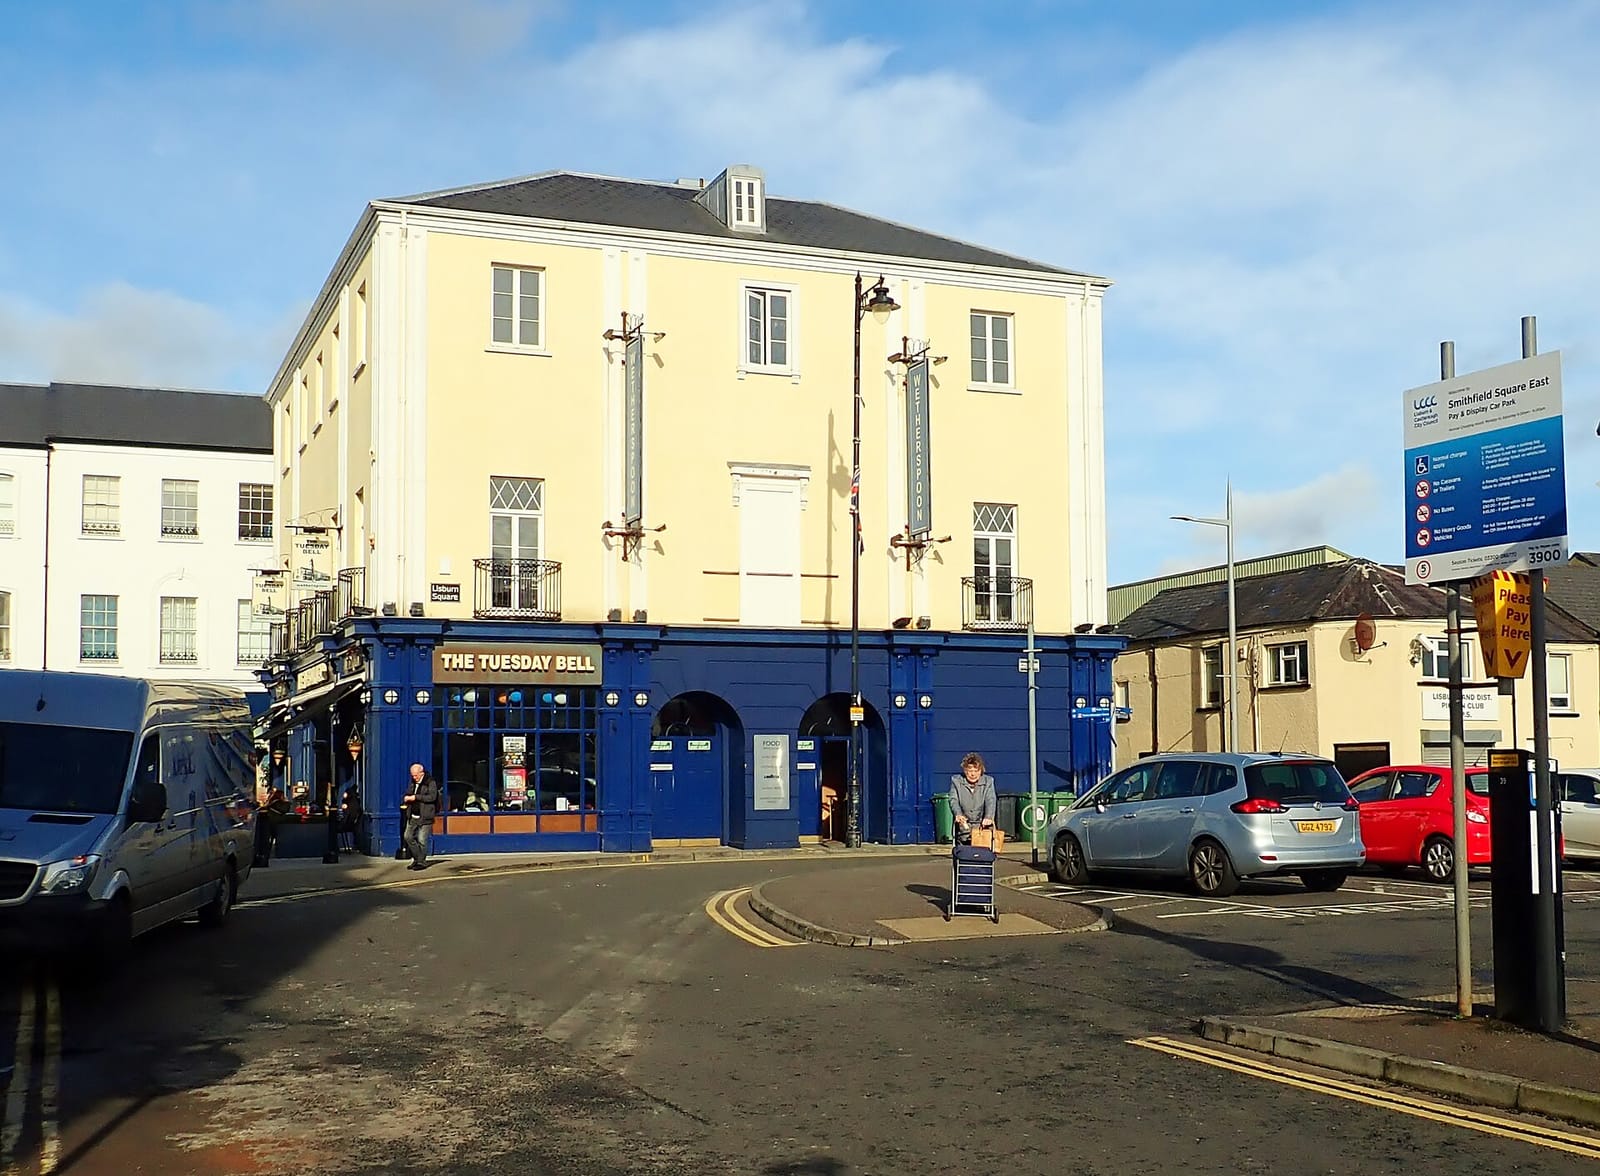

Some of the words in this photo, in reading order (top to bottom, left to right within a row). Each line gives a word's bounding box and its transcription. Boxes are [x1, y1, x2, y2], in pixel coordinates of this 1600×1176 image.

[1448, 390, 1492, 408] Smithfield
[1494, 383, 1526, 398] Square
[1529, 376, 1550, 388] East
[1466, 406, 1488, 416] Display
[913, 374, 922, 522] WETHERSPOON
[1528, 550, 1560, 564] 3900
[1421, 564, 1426, 572] 5
[432, 584, 459, 593] Lisburn
[432, 593, 459, 601] Square
[1500, 589, 1531, 605] Pleas
[1506, 608, 1528, 625] Pay
[1501, 624, 1530, 640] Here
[441, 654, 475, 670] THE
[479, 654, 552, 671] TUESDAY
[555, 656, 595, 672] BELL
